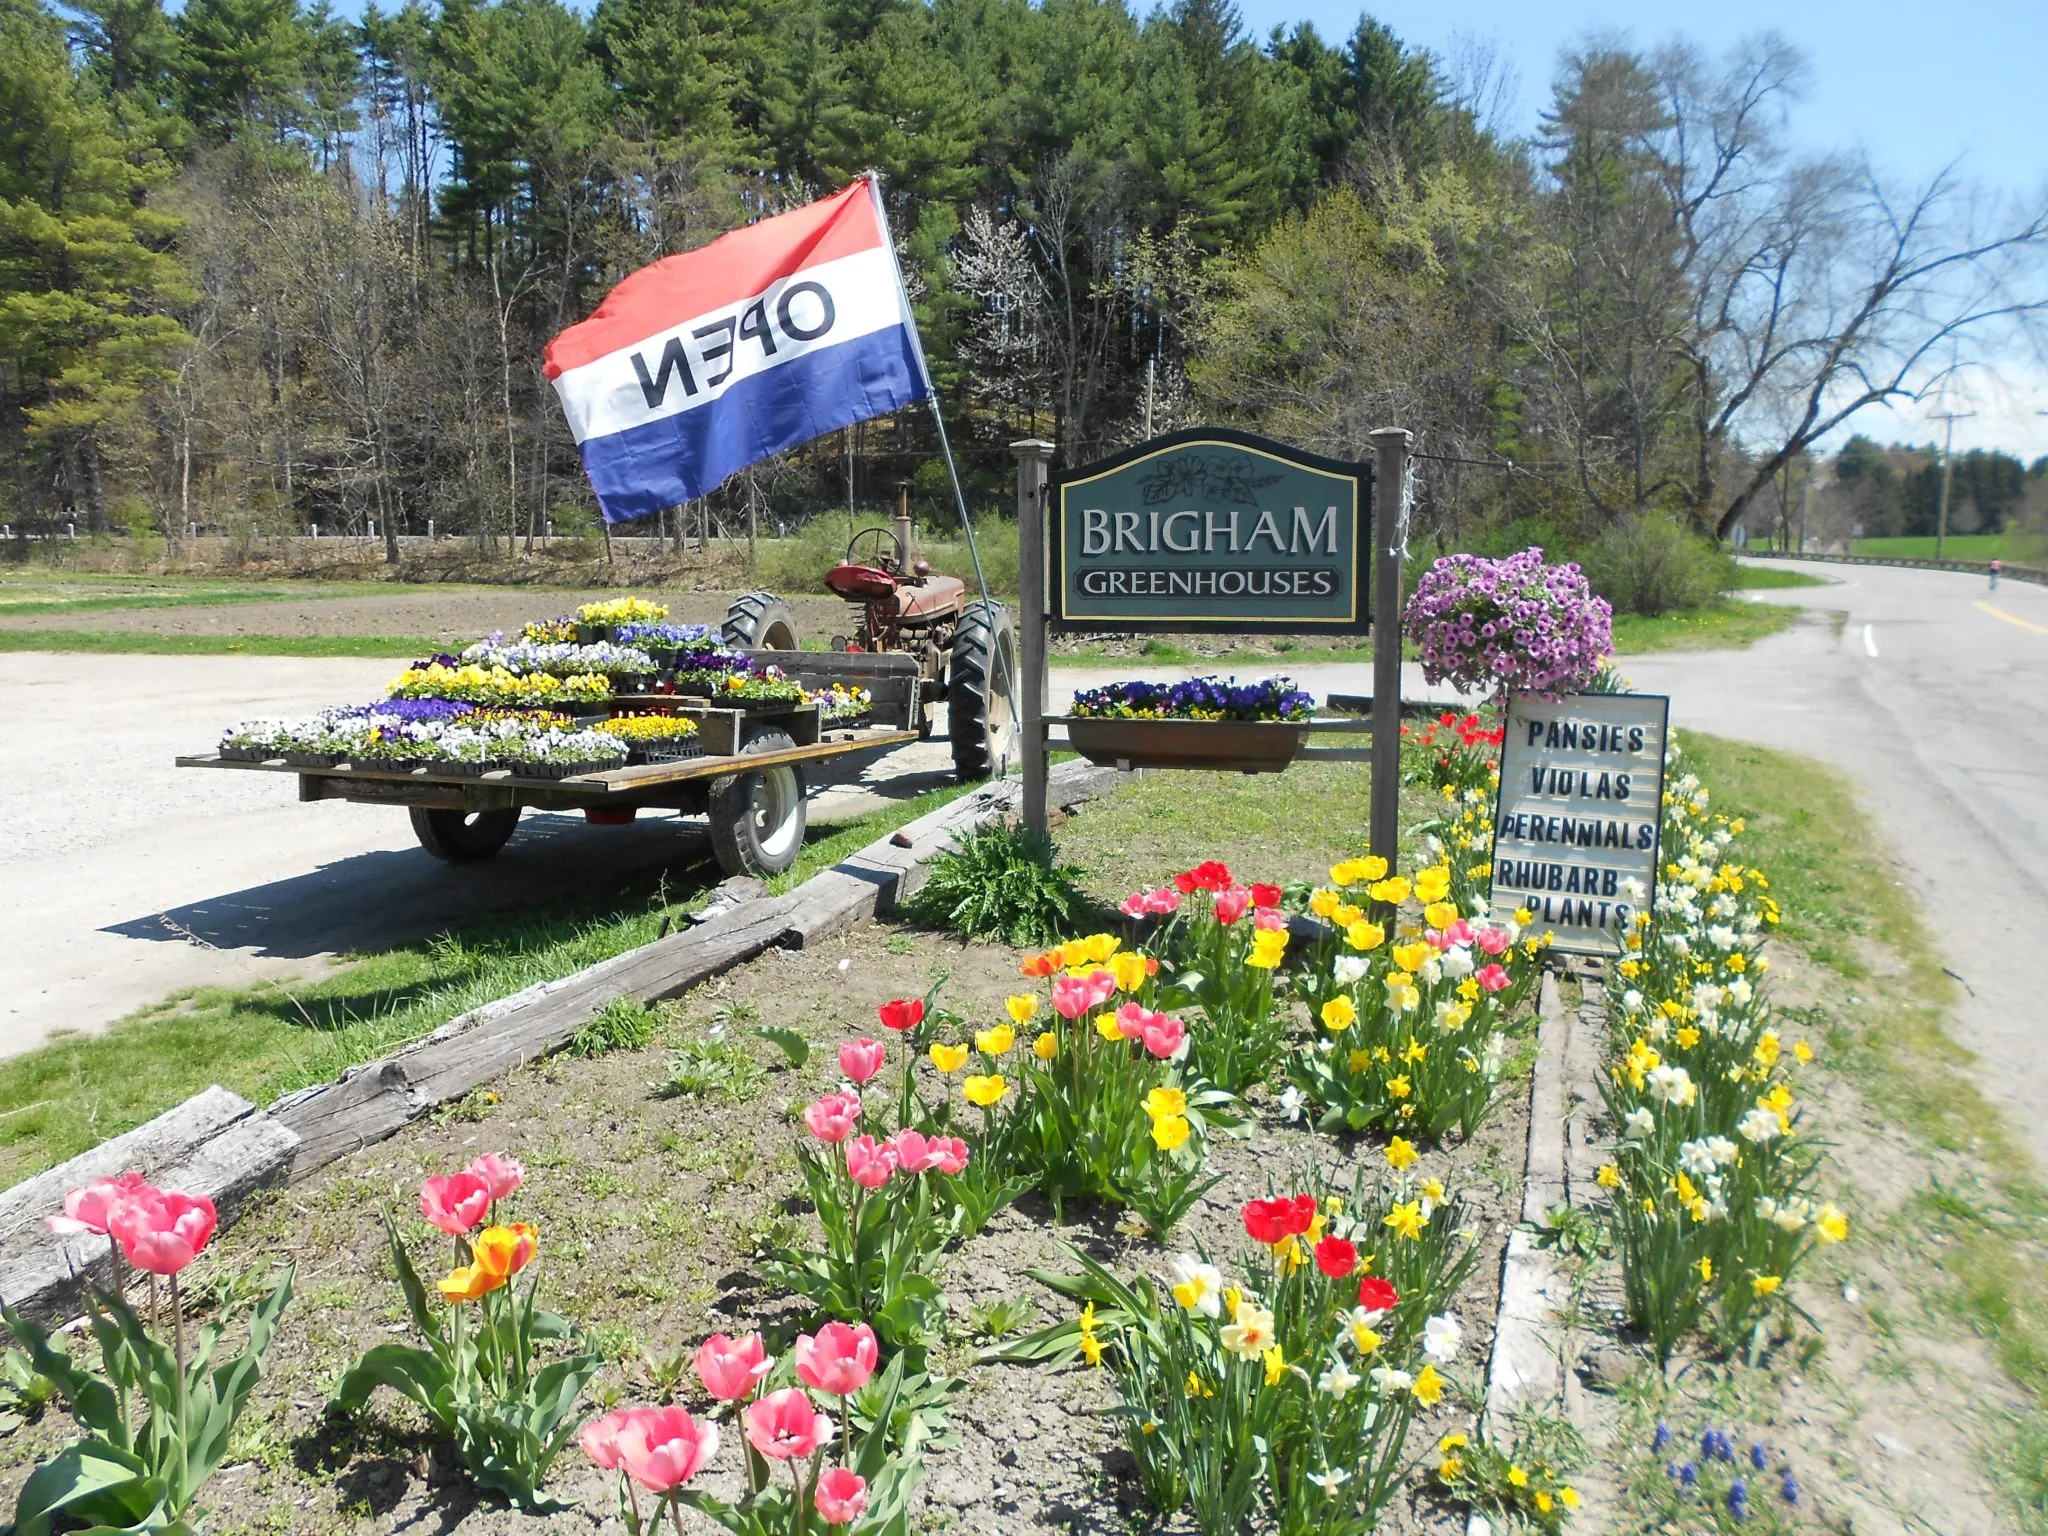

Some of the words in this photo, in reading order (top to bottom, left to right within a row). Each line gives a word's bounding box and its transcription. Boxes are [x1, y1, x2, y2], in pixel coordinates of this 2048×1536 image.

[1082, 506, 1338, 554] BRIGHAM
[1083, 571, 1332, 595] GREENHOUSES
[1528, 720, 1644, 753] PANSIES
[1532, 767, 1631, 800] VIOLAS
[1500, 813, 1654, 850] PERENNIALS
[1499, 860, 1619, 897] RHUBARB
[1527, 895, 1630, 930] PLANTS
